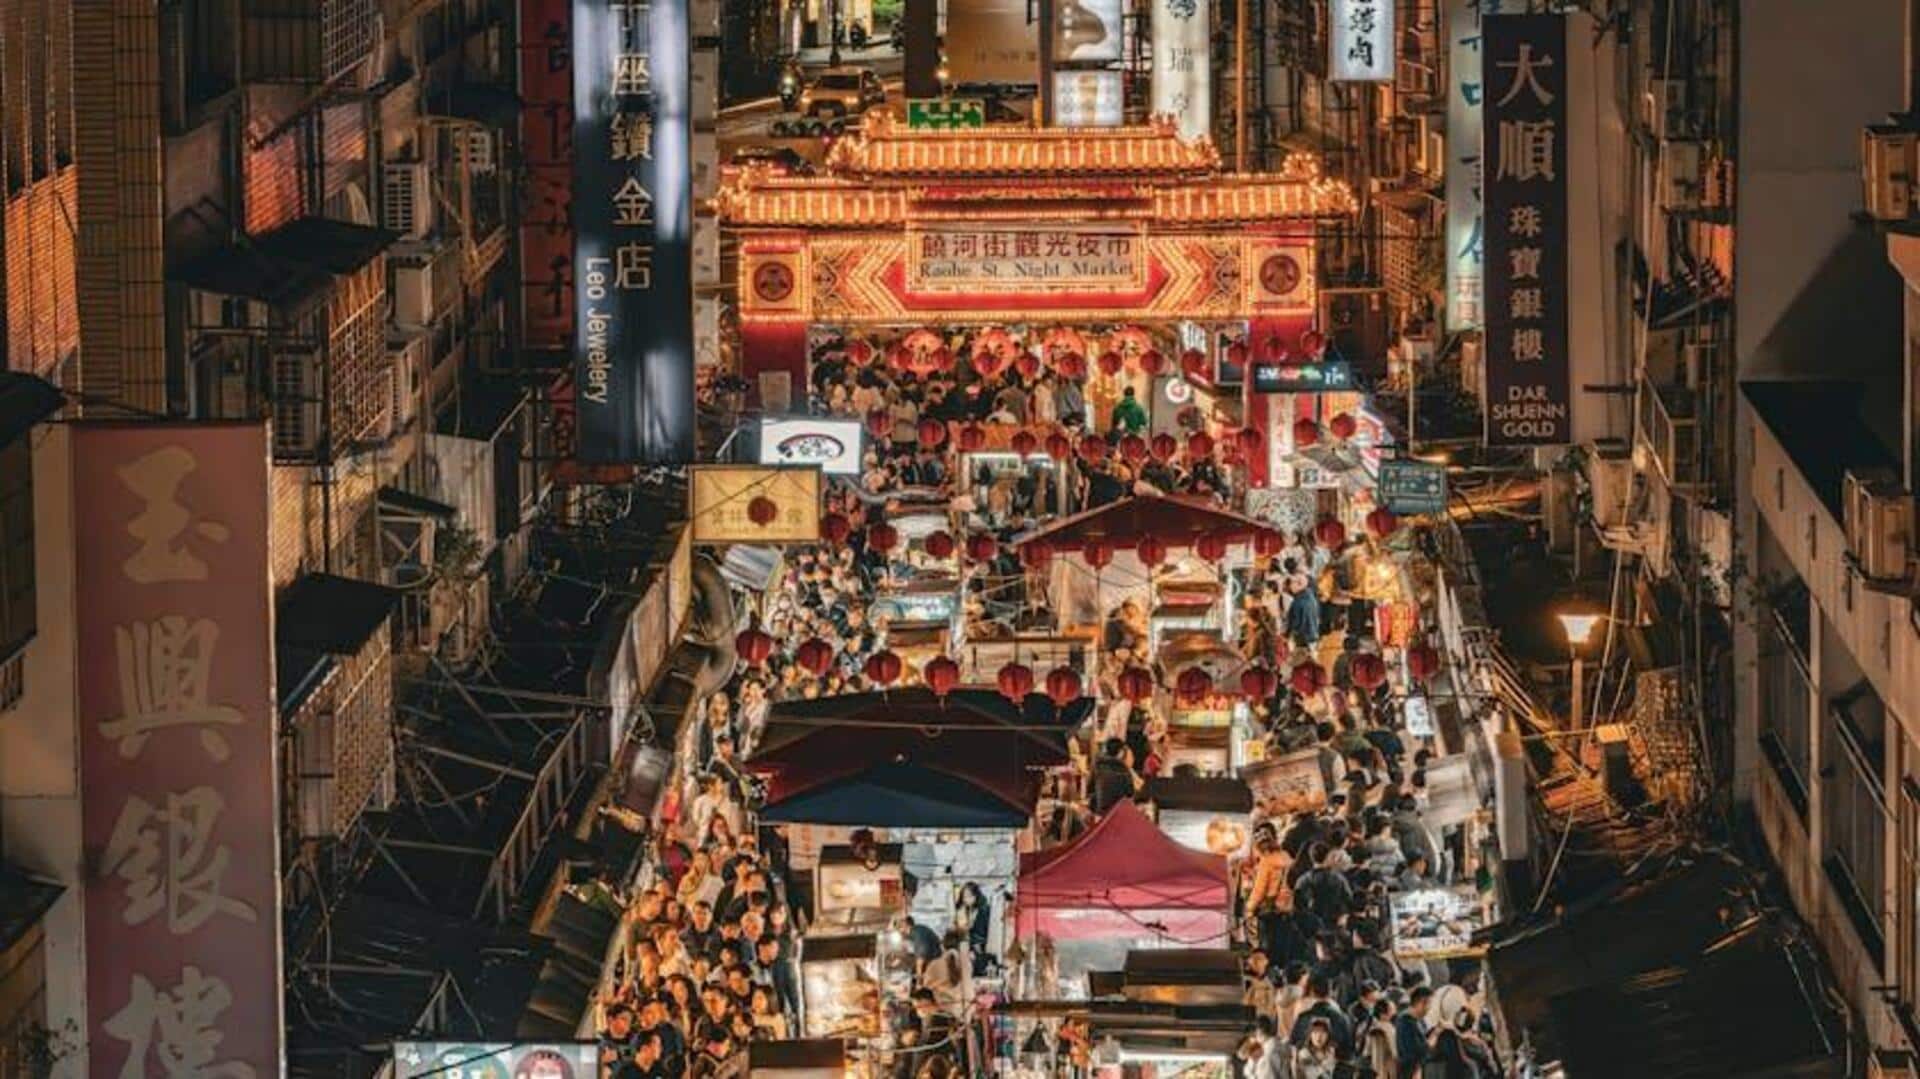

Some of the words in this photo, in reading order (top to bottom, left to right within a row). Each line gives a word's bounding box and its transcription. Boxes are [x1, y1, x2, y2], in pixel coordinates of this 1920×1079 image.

[922, 231, 1131, 258] 饒河街觀光夜市
[586, 257, 610, 300] Leo
[920, 261, 971, 278] Raohe
[1015, 261, 1060, 279] Night
[1072, 260, 1134, 277] Market
[584, 307, 613, 404] Jewelery
[1508, 385, 1548, 402] DAR
[1493, 403, 1566, 421] SHUENN
[1502, 421, 1555, 438] GOLD
